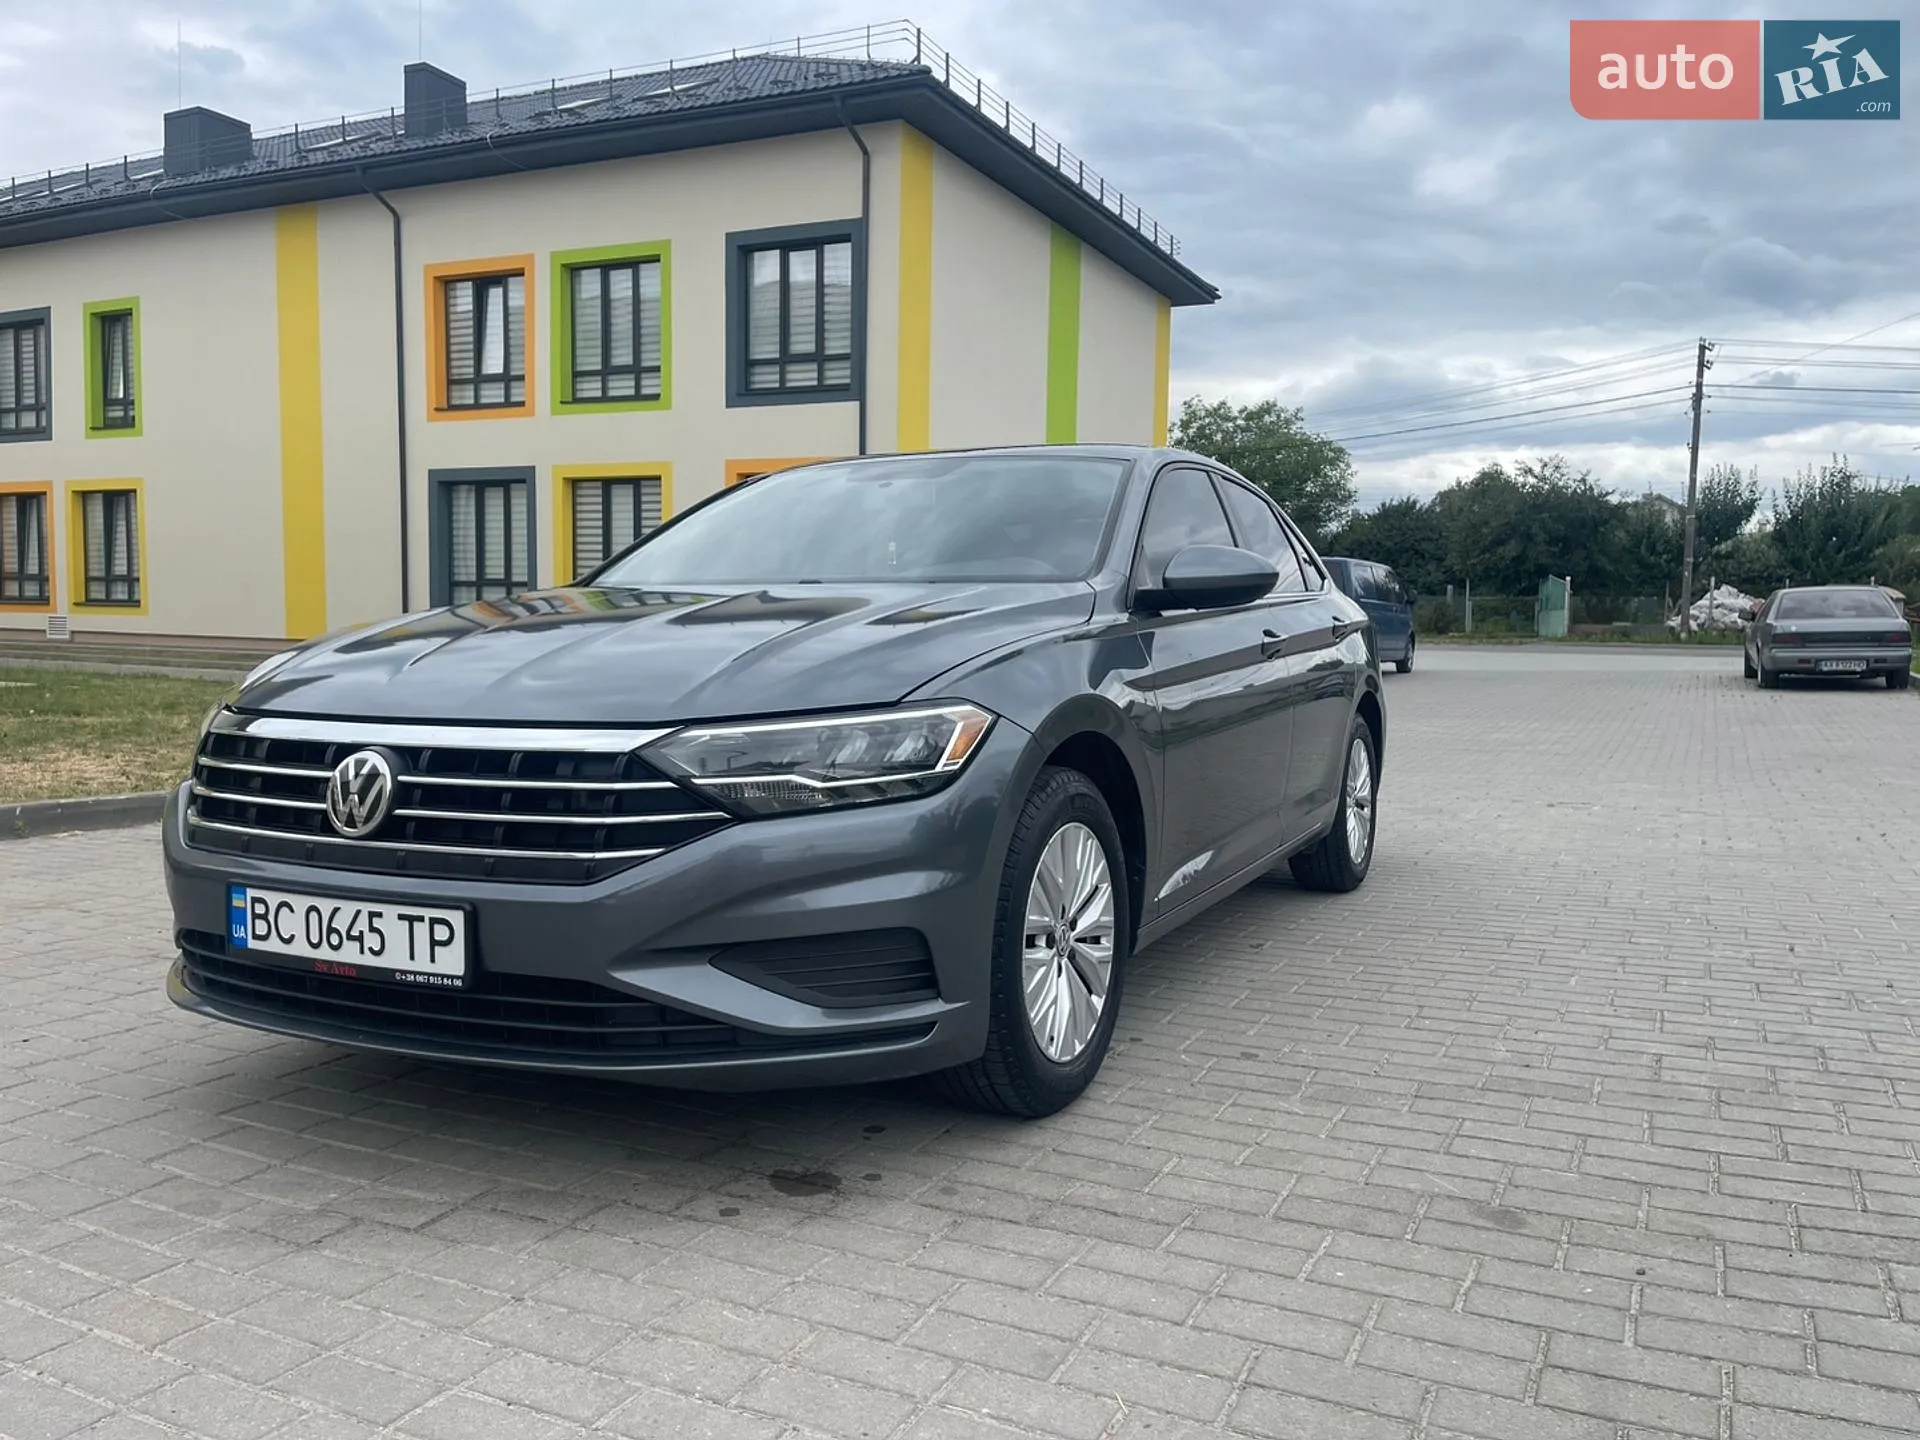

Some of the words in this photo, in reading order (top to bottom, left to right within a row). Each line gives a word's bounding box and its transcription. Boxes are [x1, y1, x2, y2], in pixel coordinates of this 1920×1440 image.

[232, 924, 247, 939] UA
[251, 896, 296, 945] BC
[305, 904, 385, 957] 0645
[397, 913, 455, 964] TP
